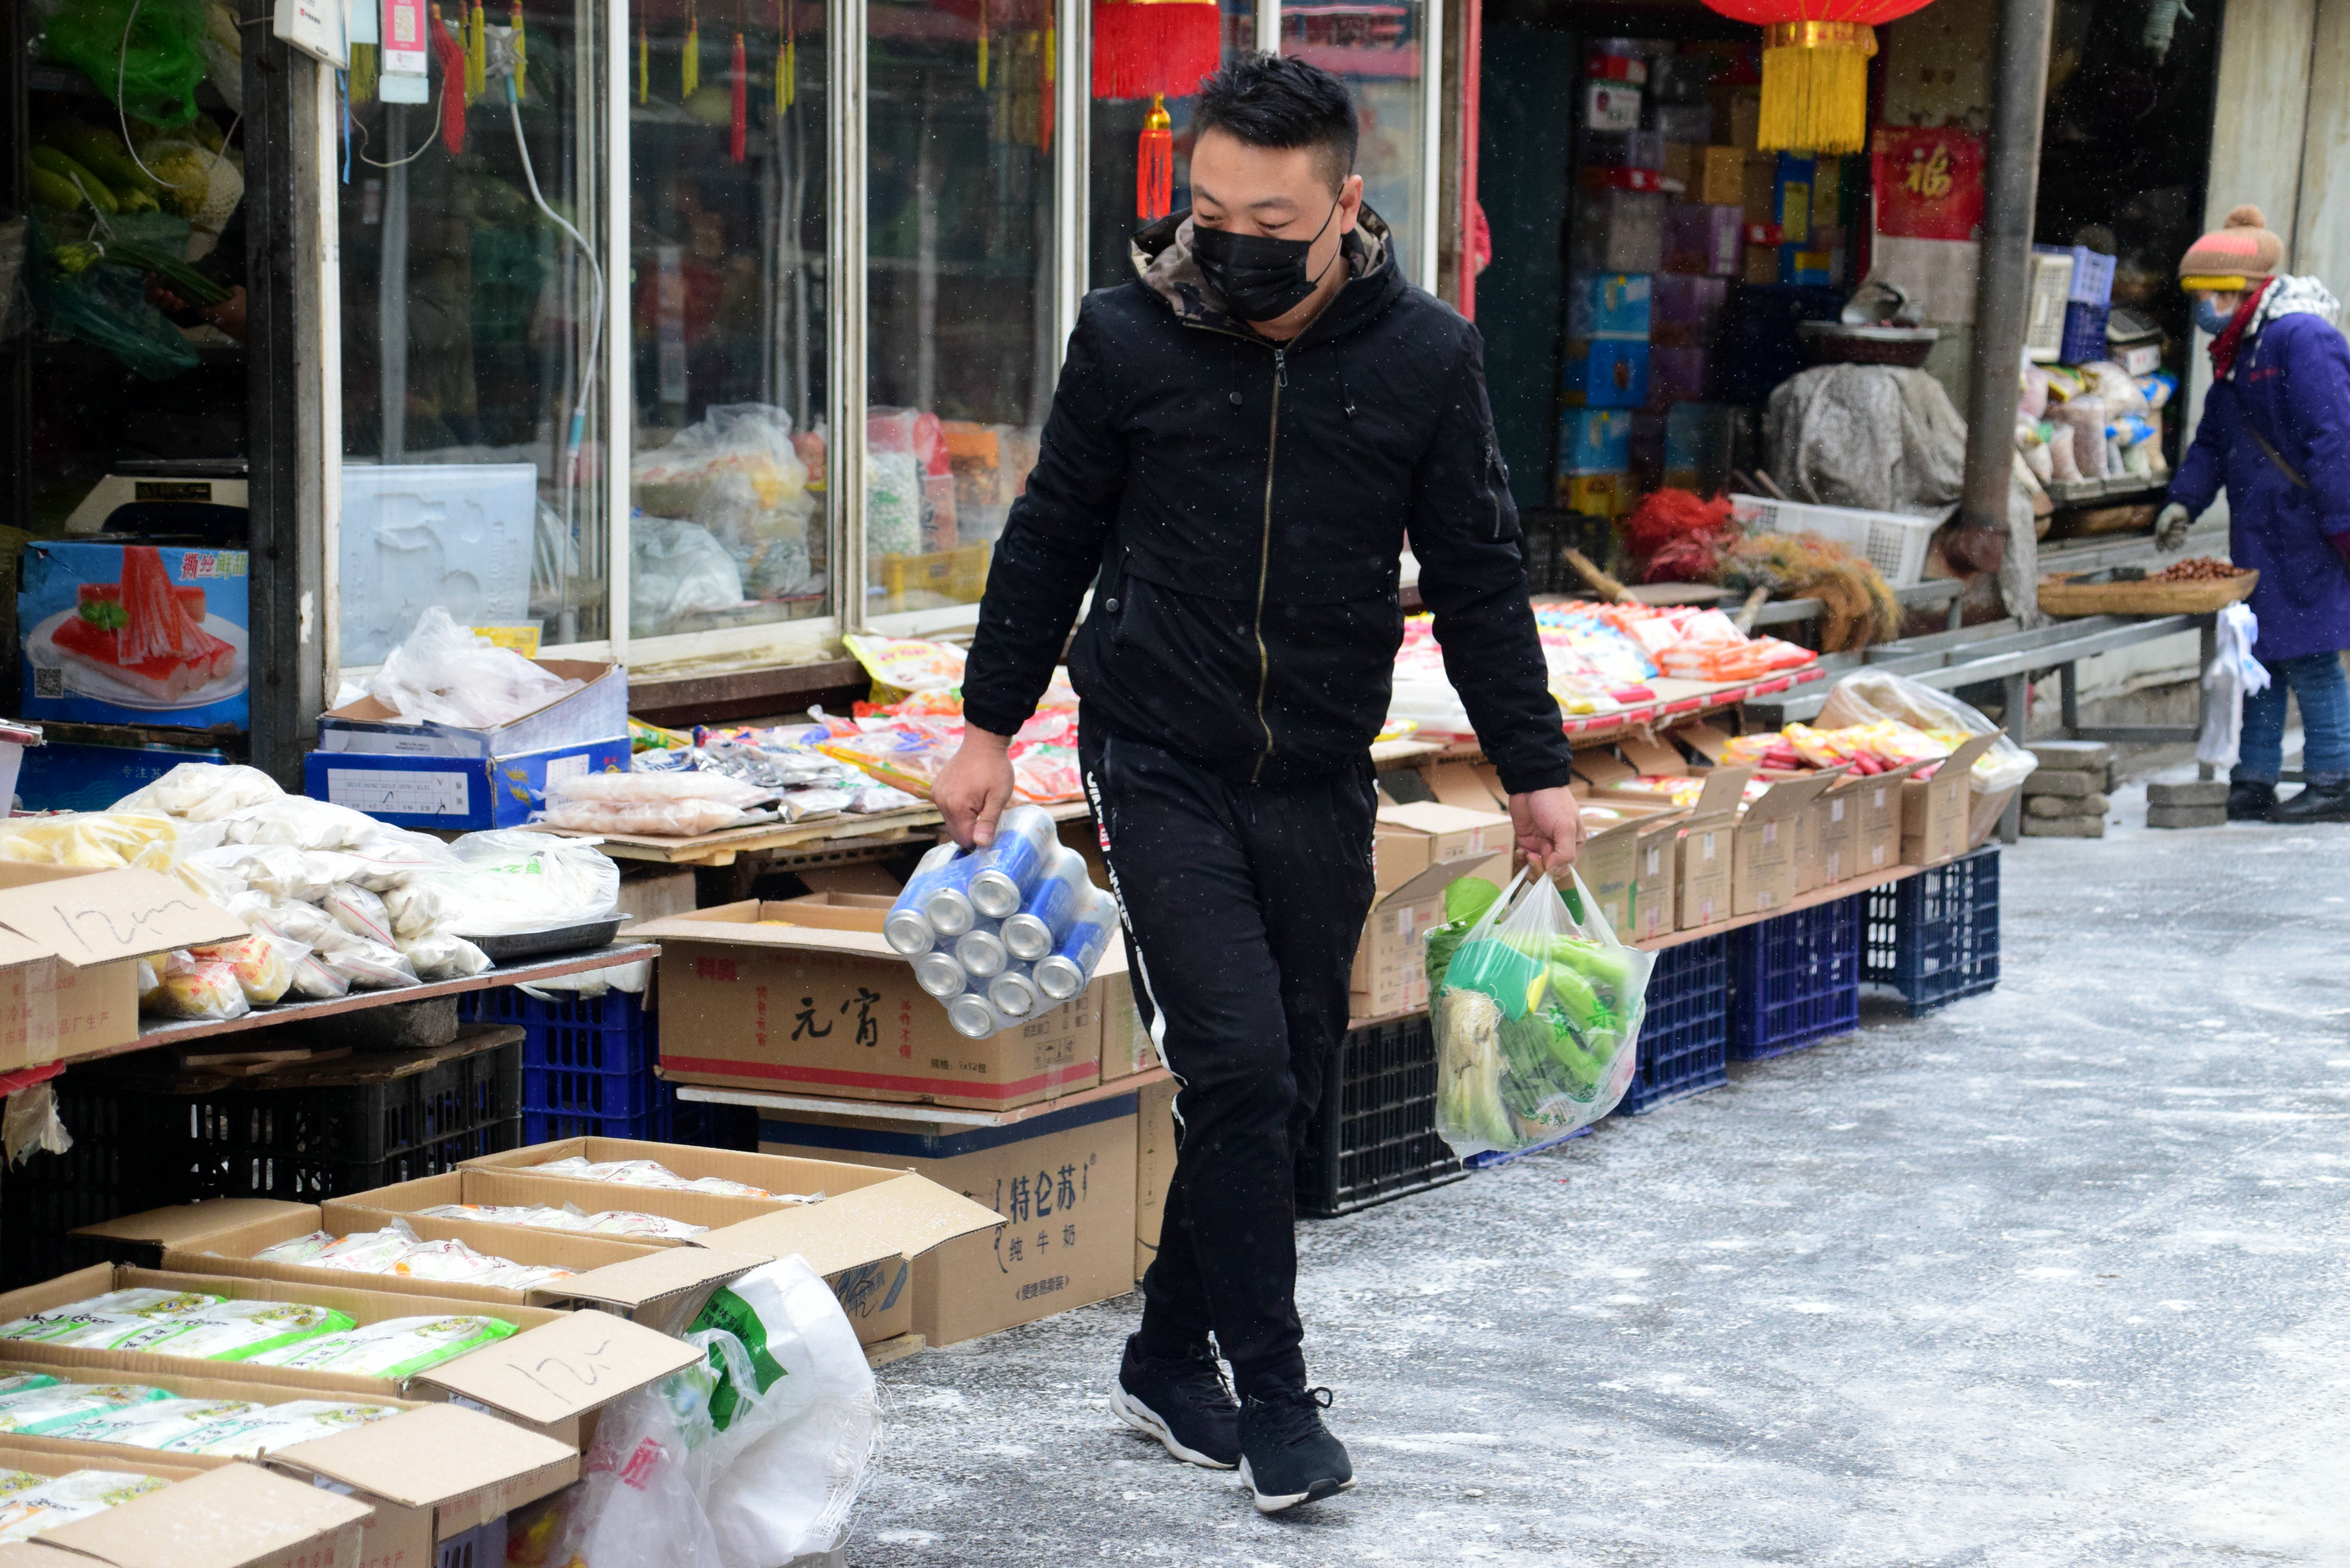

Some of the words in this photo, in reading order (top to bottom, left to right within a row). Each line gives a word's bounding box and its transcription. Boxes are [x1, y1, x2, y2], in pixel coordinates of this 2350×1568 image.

[1905, 145, 1953, 199] 福
[179, 551, 249, 581] 撕丝鲜甜
[120, 765, 167, 779] 专注苏
[791, 987, 881, 1047] 元宵
[1010, 1163, 1077, 1225] 特仑苏
[1009, 1224, 1076, 1263] 纯牛奶
[708, 1299, 750, 1342] 理体系认证
